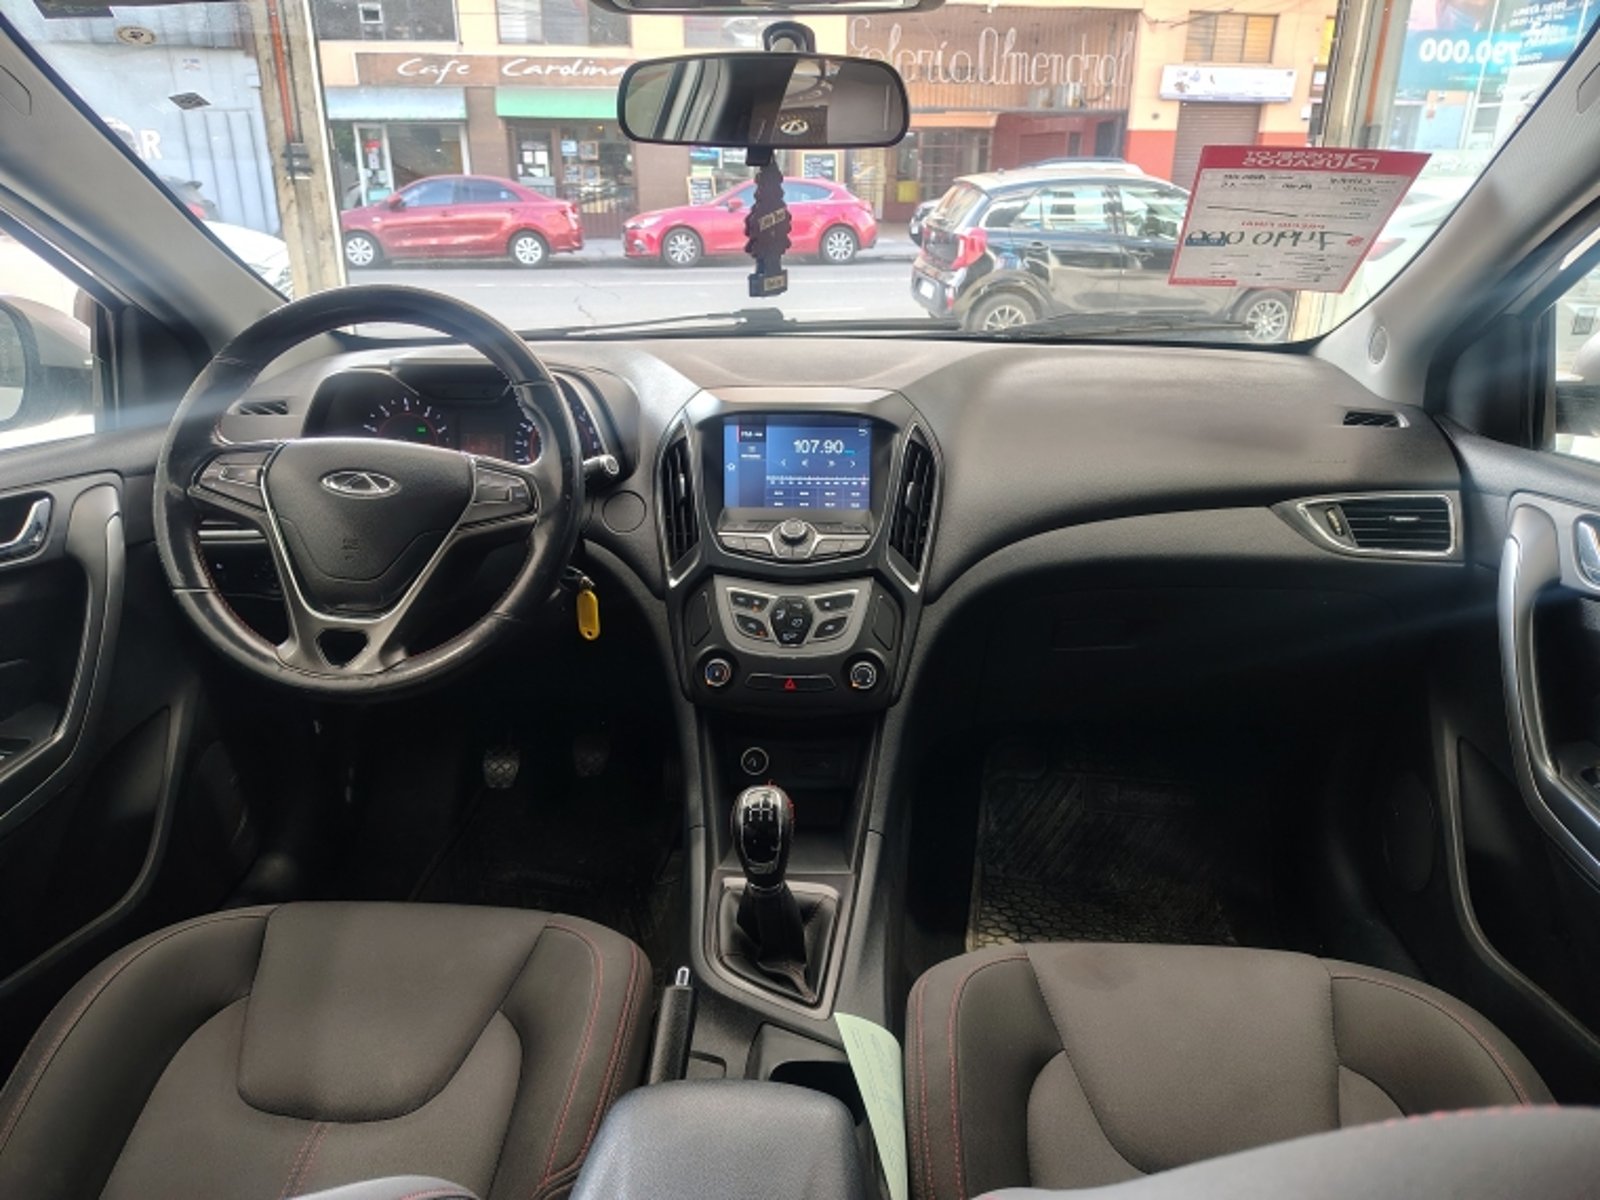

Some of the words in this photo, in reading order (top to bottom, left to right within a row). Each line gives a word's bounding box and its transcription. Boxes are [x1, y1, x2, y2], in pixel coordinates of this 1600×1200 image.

[979, 27, 1135, 86] Almendral
[397, 58, 471, 84] Cafe
[793, 439, 845, 454] 107.90
